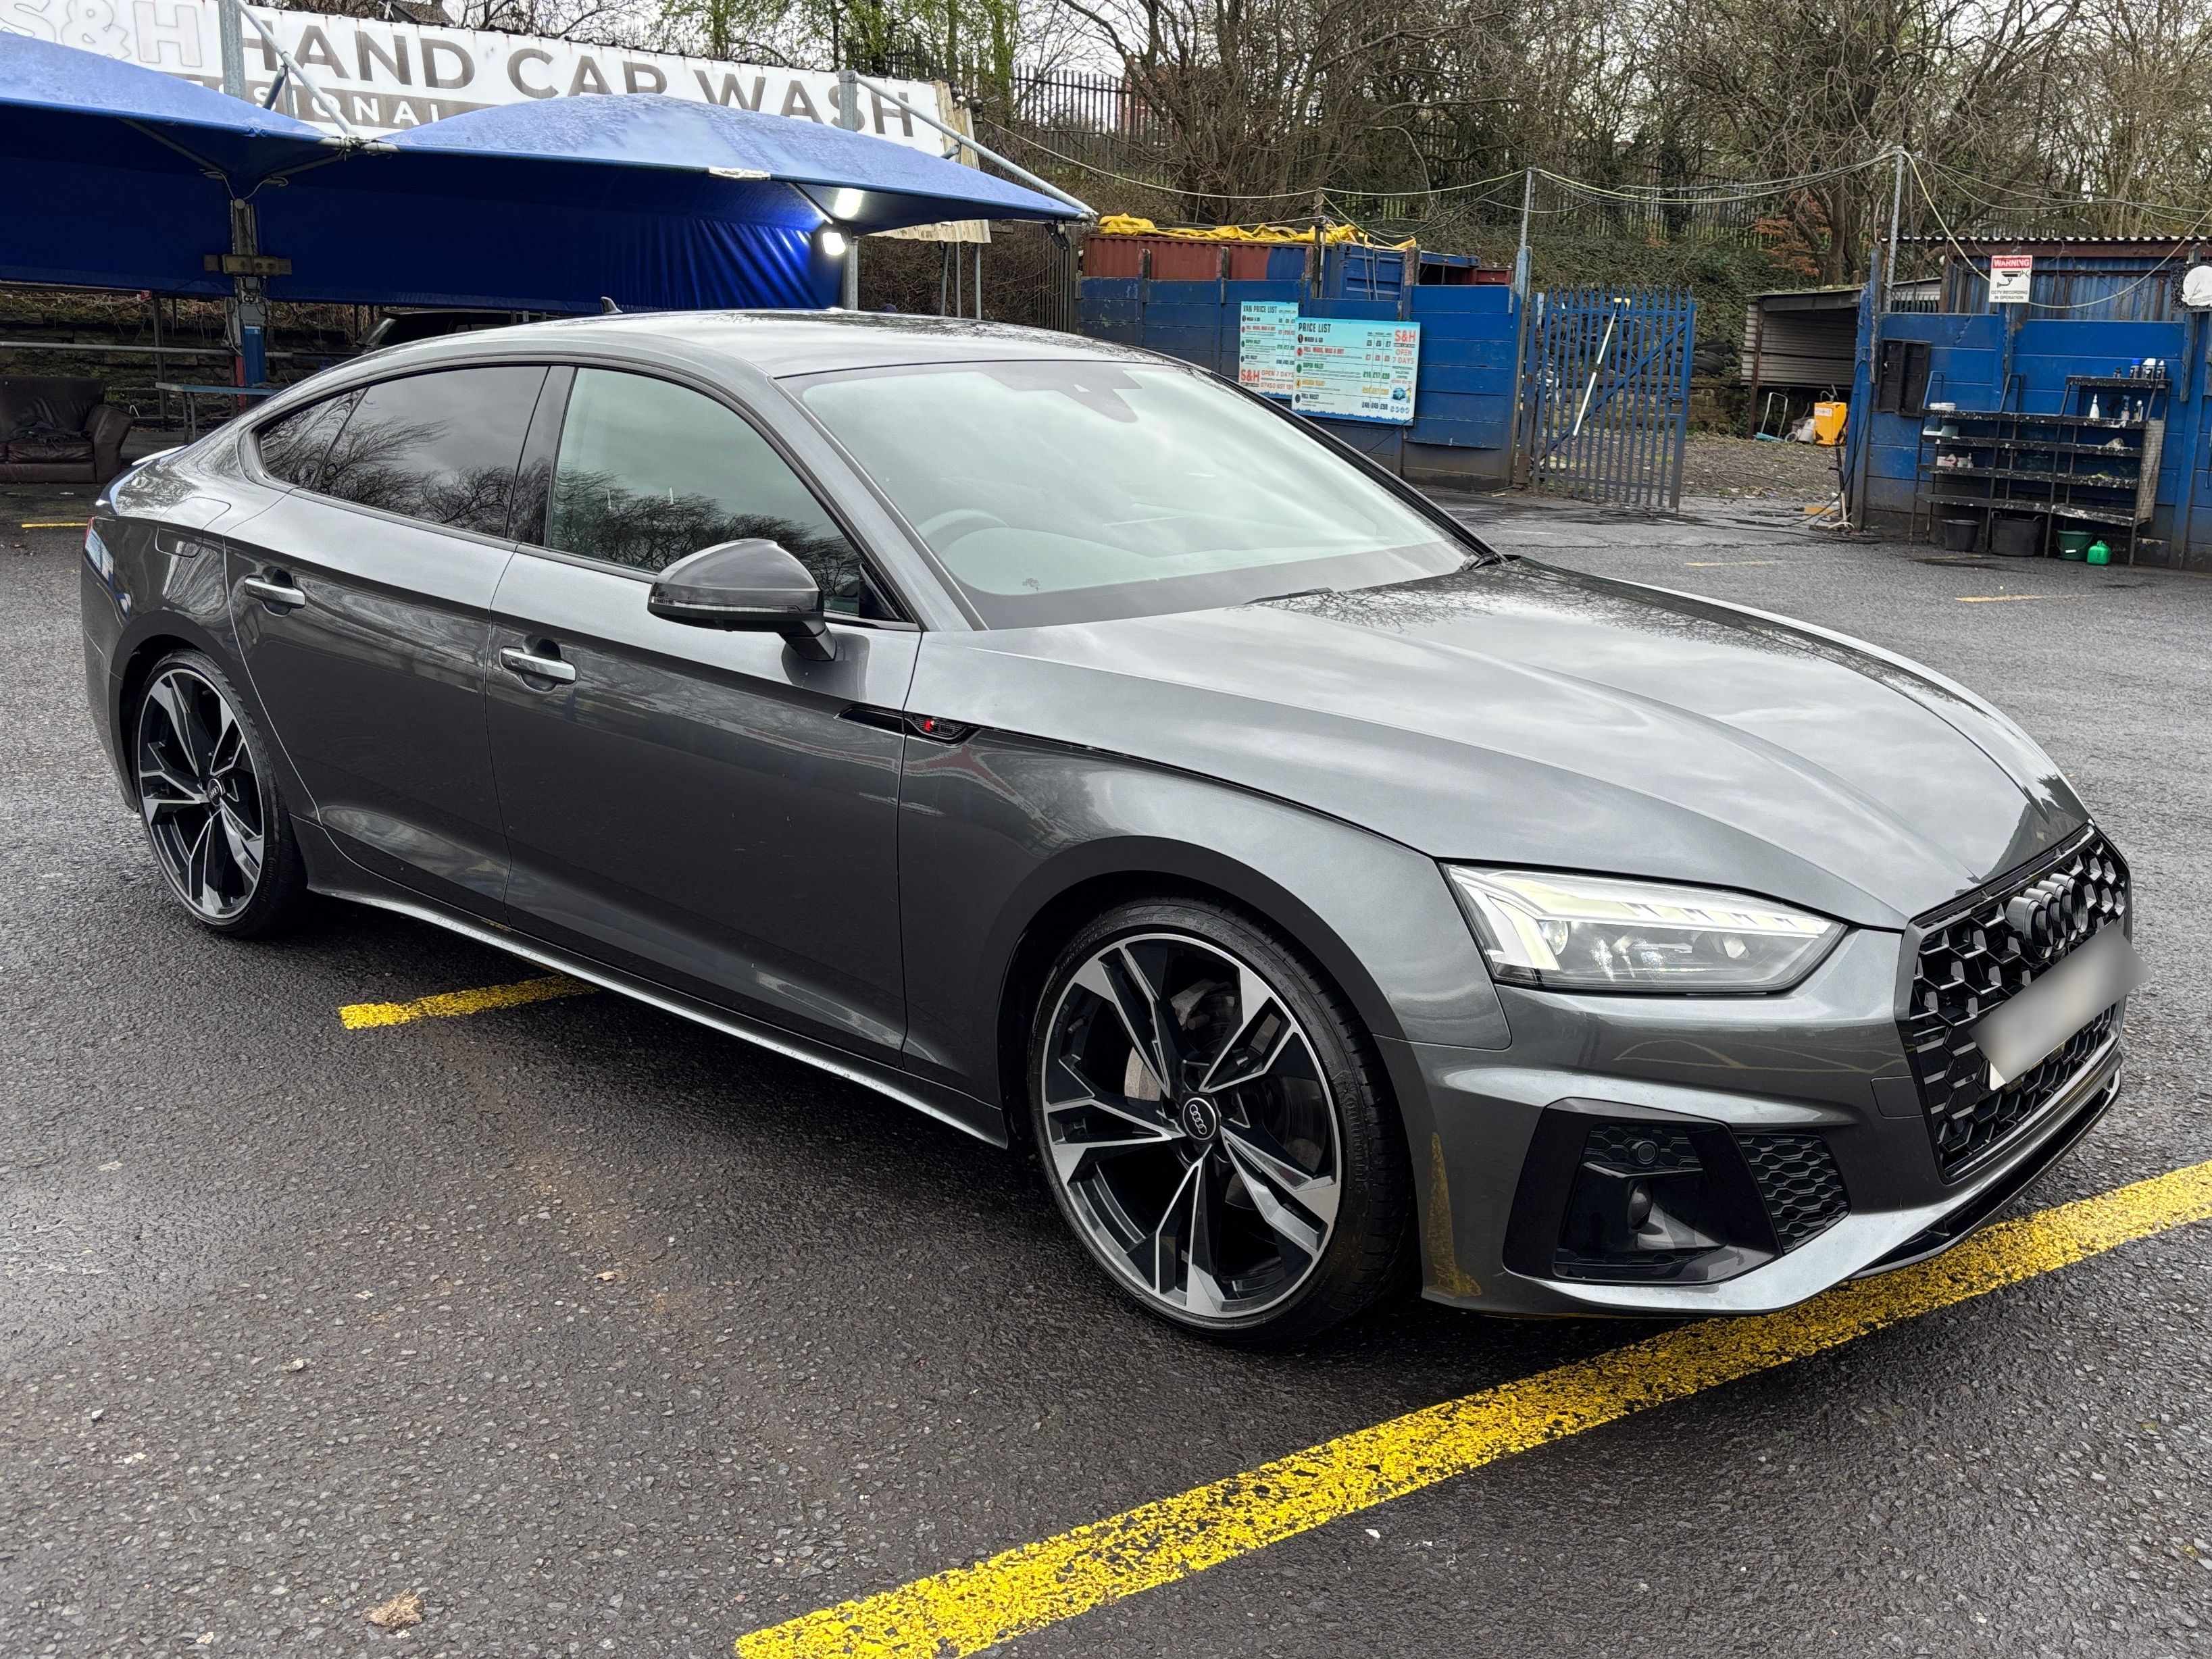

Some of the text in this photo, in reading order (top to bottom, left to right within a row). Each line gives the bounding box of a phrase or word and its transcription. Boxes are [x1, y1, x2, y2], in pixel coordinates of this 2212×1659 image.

[1267, 305, 1278, 313] LIST
[1299, 322, 1316, 332] PRICE
[1318, 324, 1331, 333] LIST
[1394, 330, 1416, 342] S&H
[1241, 369, 1260, 382] S&H
